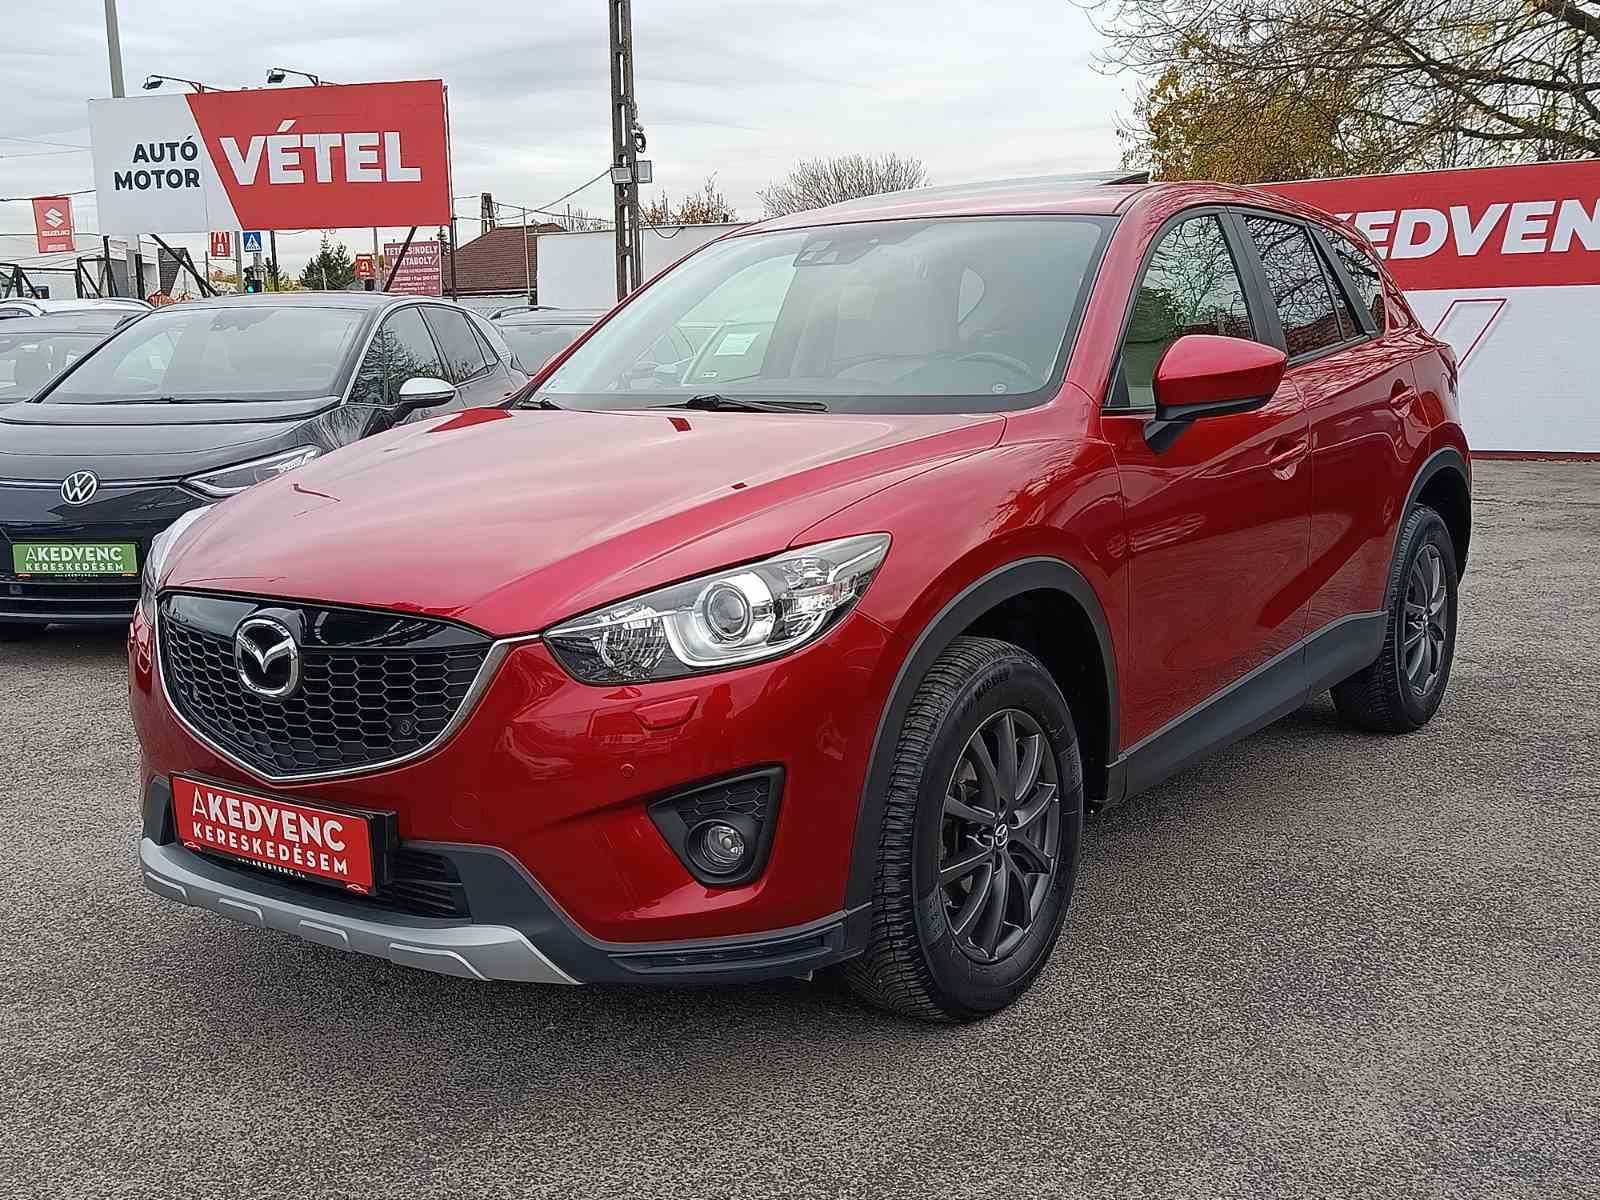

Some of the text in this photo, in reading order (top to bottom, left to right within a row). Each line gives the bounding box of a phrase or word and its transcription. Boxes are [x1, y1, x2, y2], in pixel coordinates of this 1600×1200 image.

[132, 135, 199, 164] AUTÓ
[218, 119, 422, 186] VÉTEL
[114, 168, 201, 191] MOTOR
[1334, 199, 1600, 259] EDVEN
[25, 562, 124, 571] KERESKEDÉSEM
[192, 821, 349, 875] KERESKEDÉSEM
